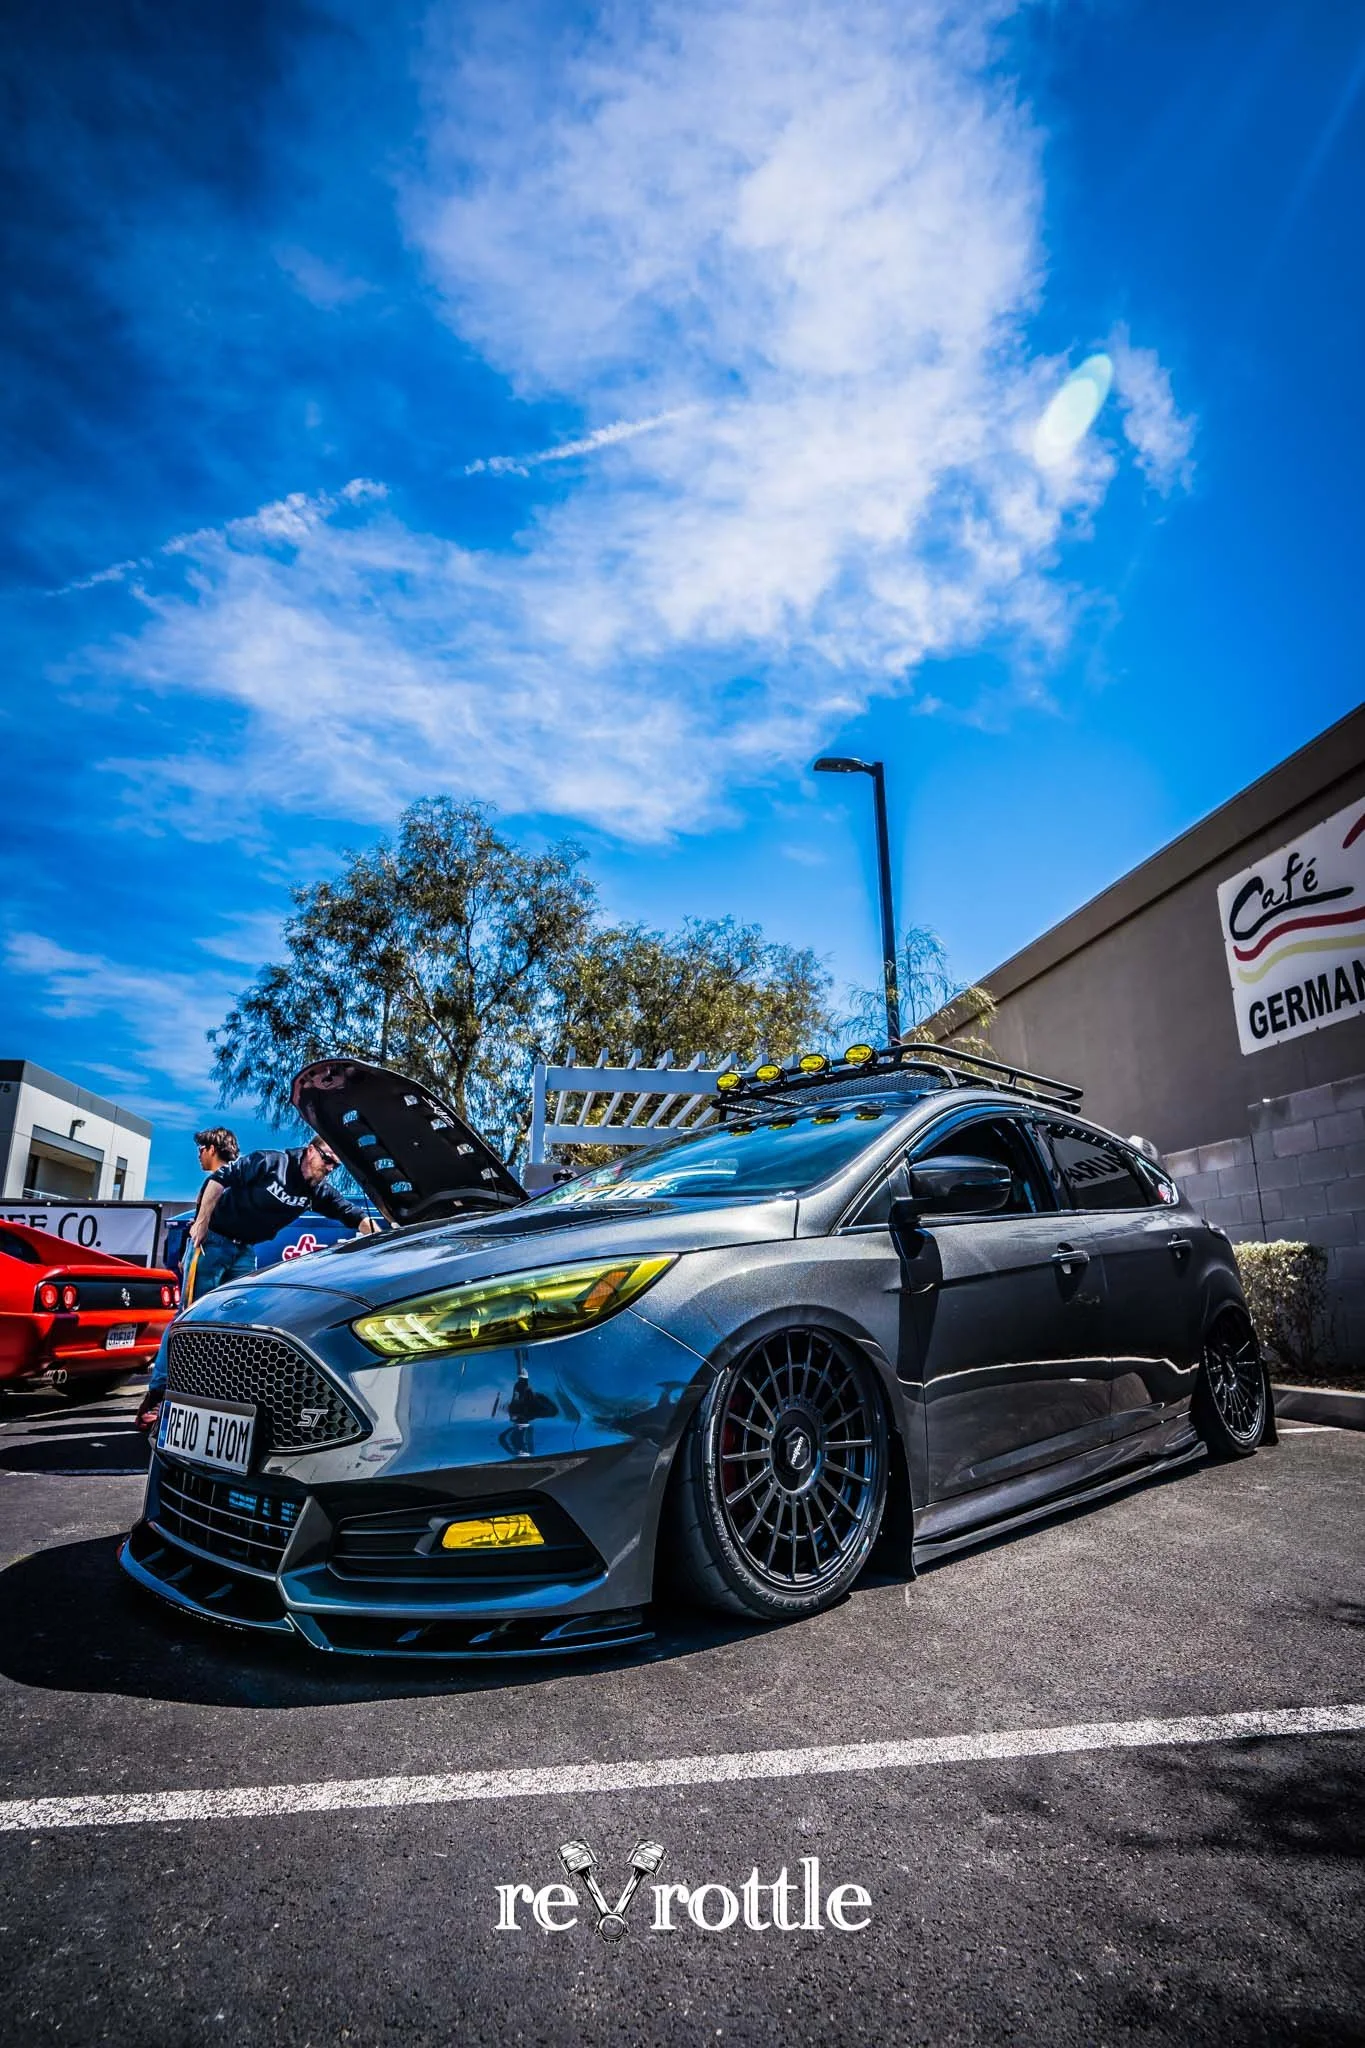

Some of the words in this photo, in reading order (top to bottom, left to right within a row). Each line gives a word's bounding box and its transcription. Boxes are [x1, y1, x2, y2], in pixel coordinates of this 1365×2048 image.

[1229, 852, 1354, 940] Café
[58, 1212, 102, 1247] CO.
[166, 1407, 199, 1451] REVO
[204, 1415, 250, 1465] EVOM
[297, 1408, 329, 1427] ST
